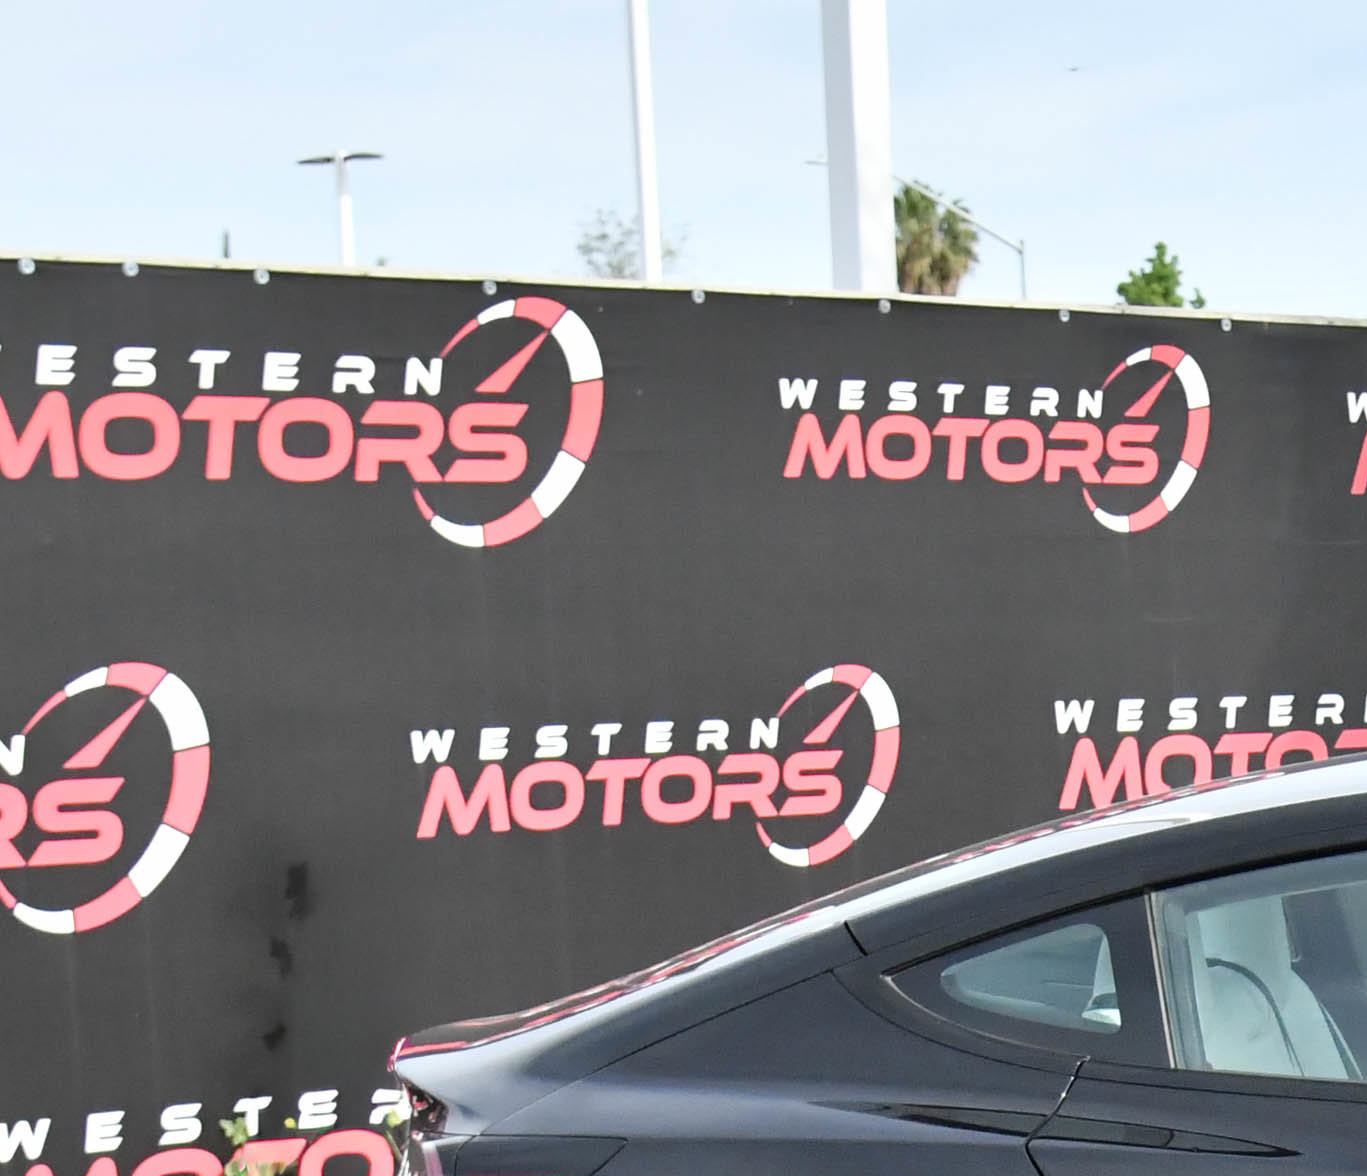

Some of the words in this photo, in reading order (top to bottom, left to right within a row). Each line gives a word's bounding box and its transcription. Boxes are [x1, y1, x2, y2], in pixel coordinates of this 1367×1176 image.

[0, 344, 443, 396] ESTERN
[779, 378, 1104, 419] WESTERN
[0, 391, 529, 483] MOTORS
[784, 413, 1160, 485] MOTORS
[410, 718, 780, 764] WESTERN
[416, 750, 843, 838] MOTORS
